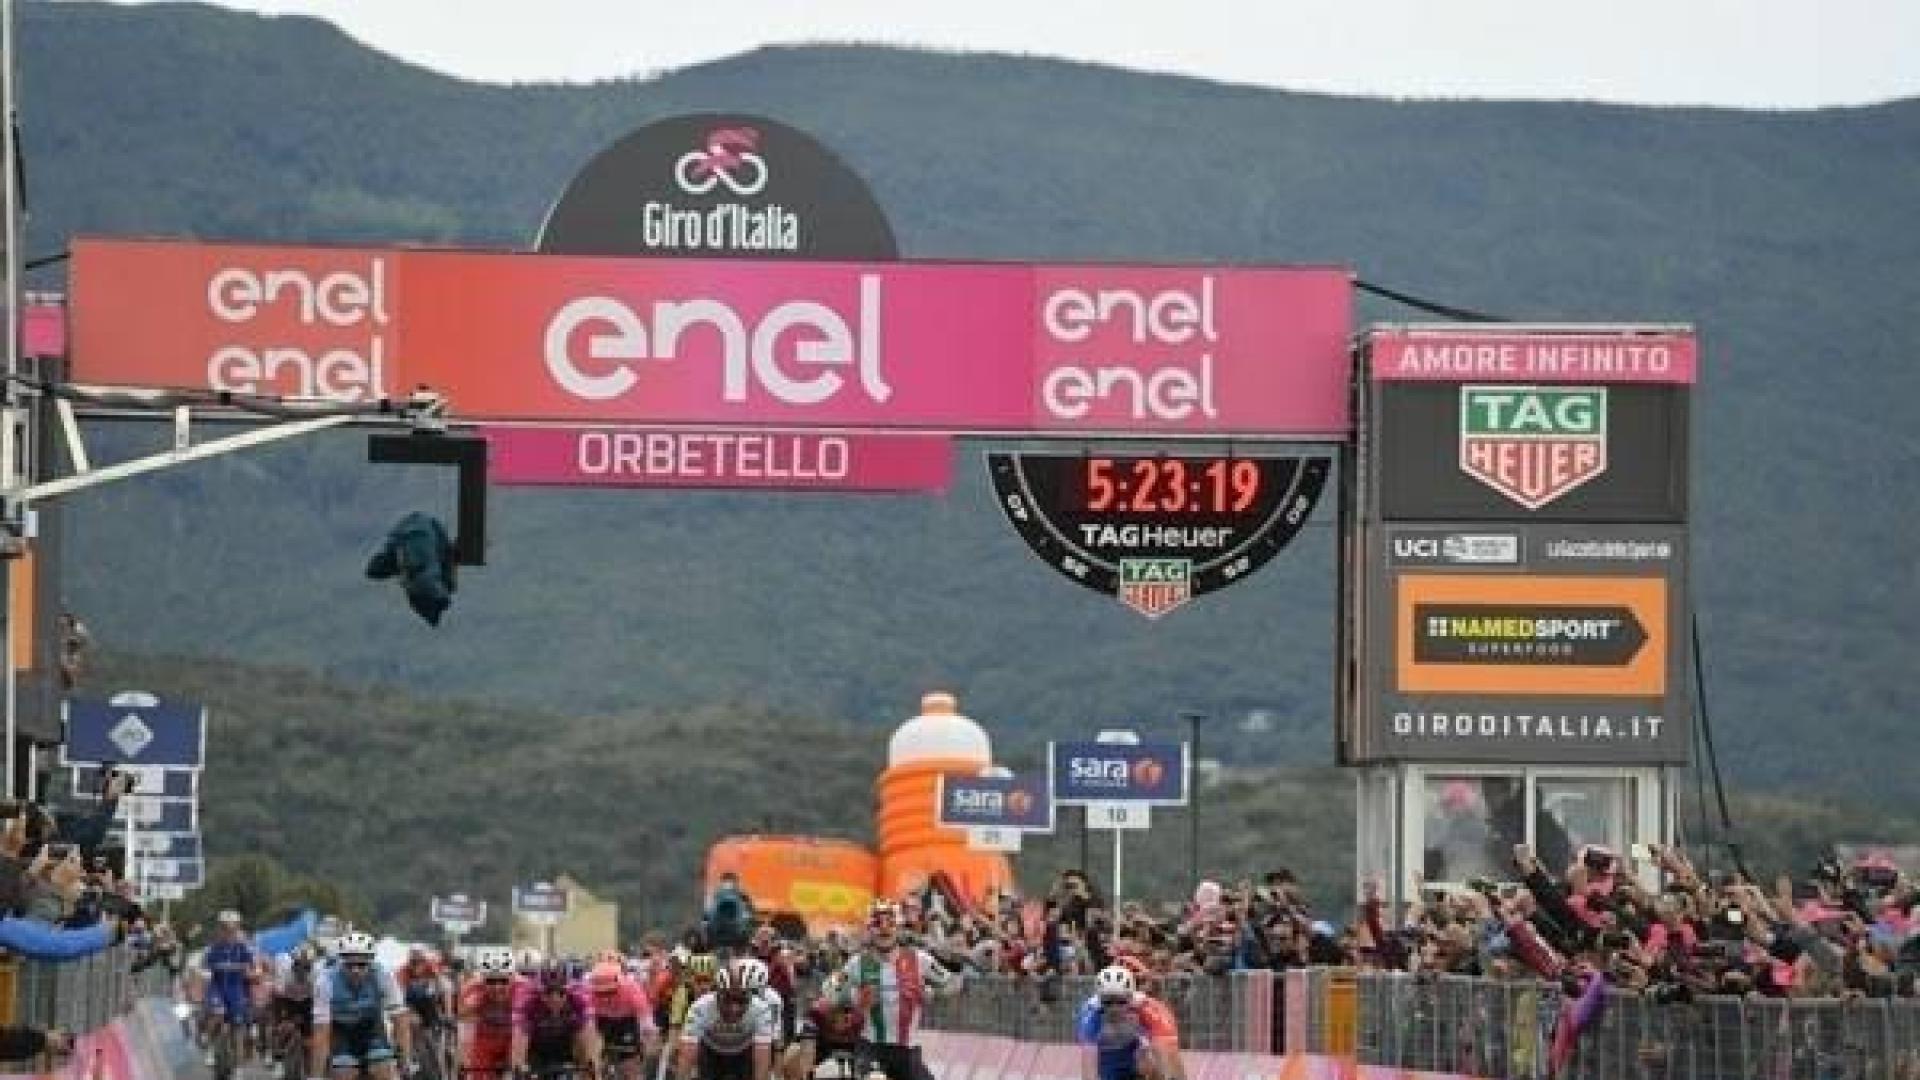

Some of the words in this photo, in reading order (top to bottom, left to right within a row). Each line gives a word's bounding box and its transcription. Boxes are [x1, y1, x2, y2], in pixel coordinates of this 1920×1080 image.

[643, 201, 701, 249] Giro
[706, 203, 799, 250] d'Italia
[207, 258, 388, 326] enel
[1043, 275, 1218, 343] enel
[544, 273, 893, 403] enel
[1400, 344, 1519, 373] AMORE
[1526, 344, 1671, 373] INFINITO
[207, 334, 388, 400] enel
[1042, 353, 1217, 419] enel
[1473, 394, 1594, 430] TAG
[577, 432, 850, 479] ORBETELLO
[1470, 442, 1598, 498] HEUER
[1086, 459, 1260, 513] 5:23:19
[1125, 561, 1185, 580] TAG
[1394, 539, 1439, 558] UCI
[1393, 712, 1665, 737] GIRODITALIA.IT
[1070, 756, 1128, 779] sara
[1107, 807, 1128, 823] 10
